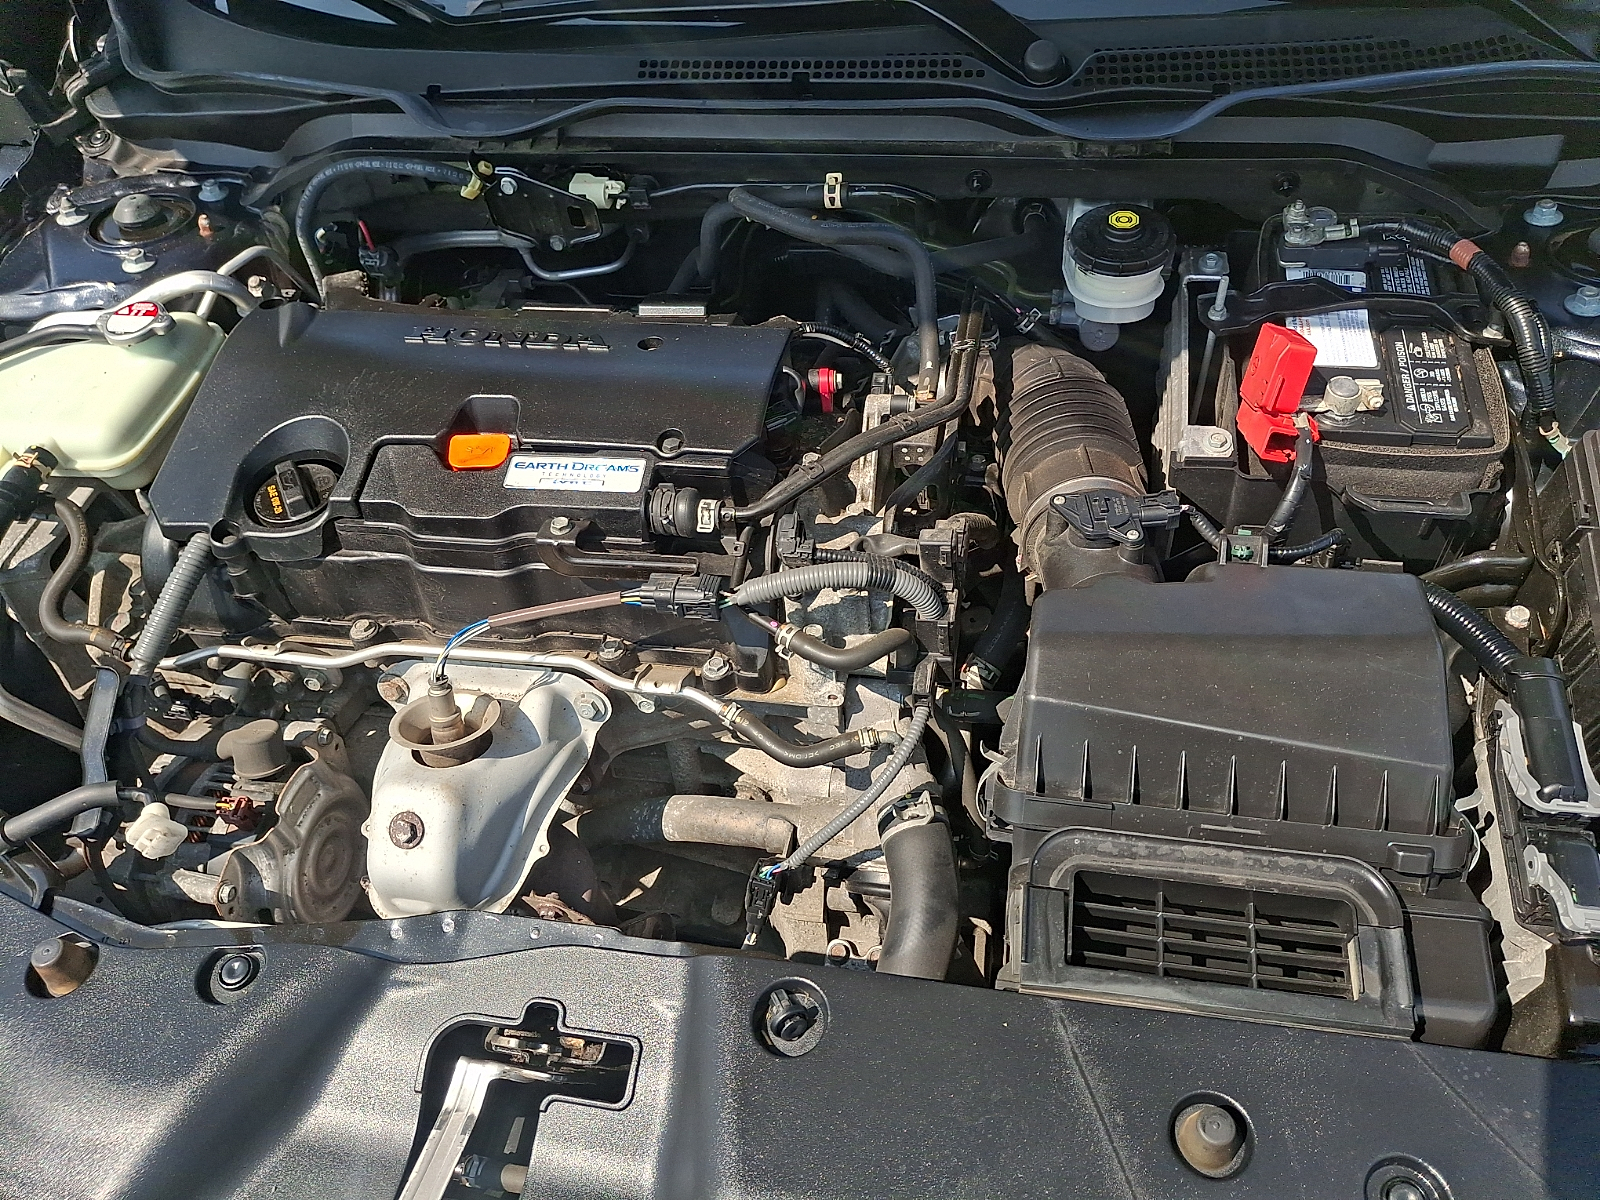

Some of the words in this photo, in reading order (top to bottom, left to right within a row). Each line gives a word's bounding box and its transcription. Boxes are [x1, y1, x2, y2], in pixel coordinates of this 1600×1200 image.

[403, 326, 611, 352] HONDA
[1395, 342, 1407, 367] POISON
[1402, 374, 1415, 403] DANGER
[514, 461, 569, 471] EARTH
[571, 462, 640, 473] DREAMS
